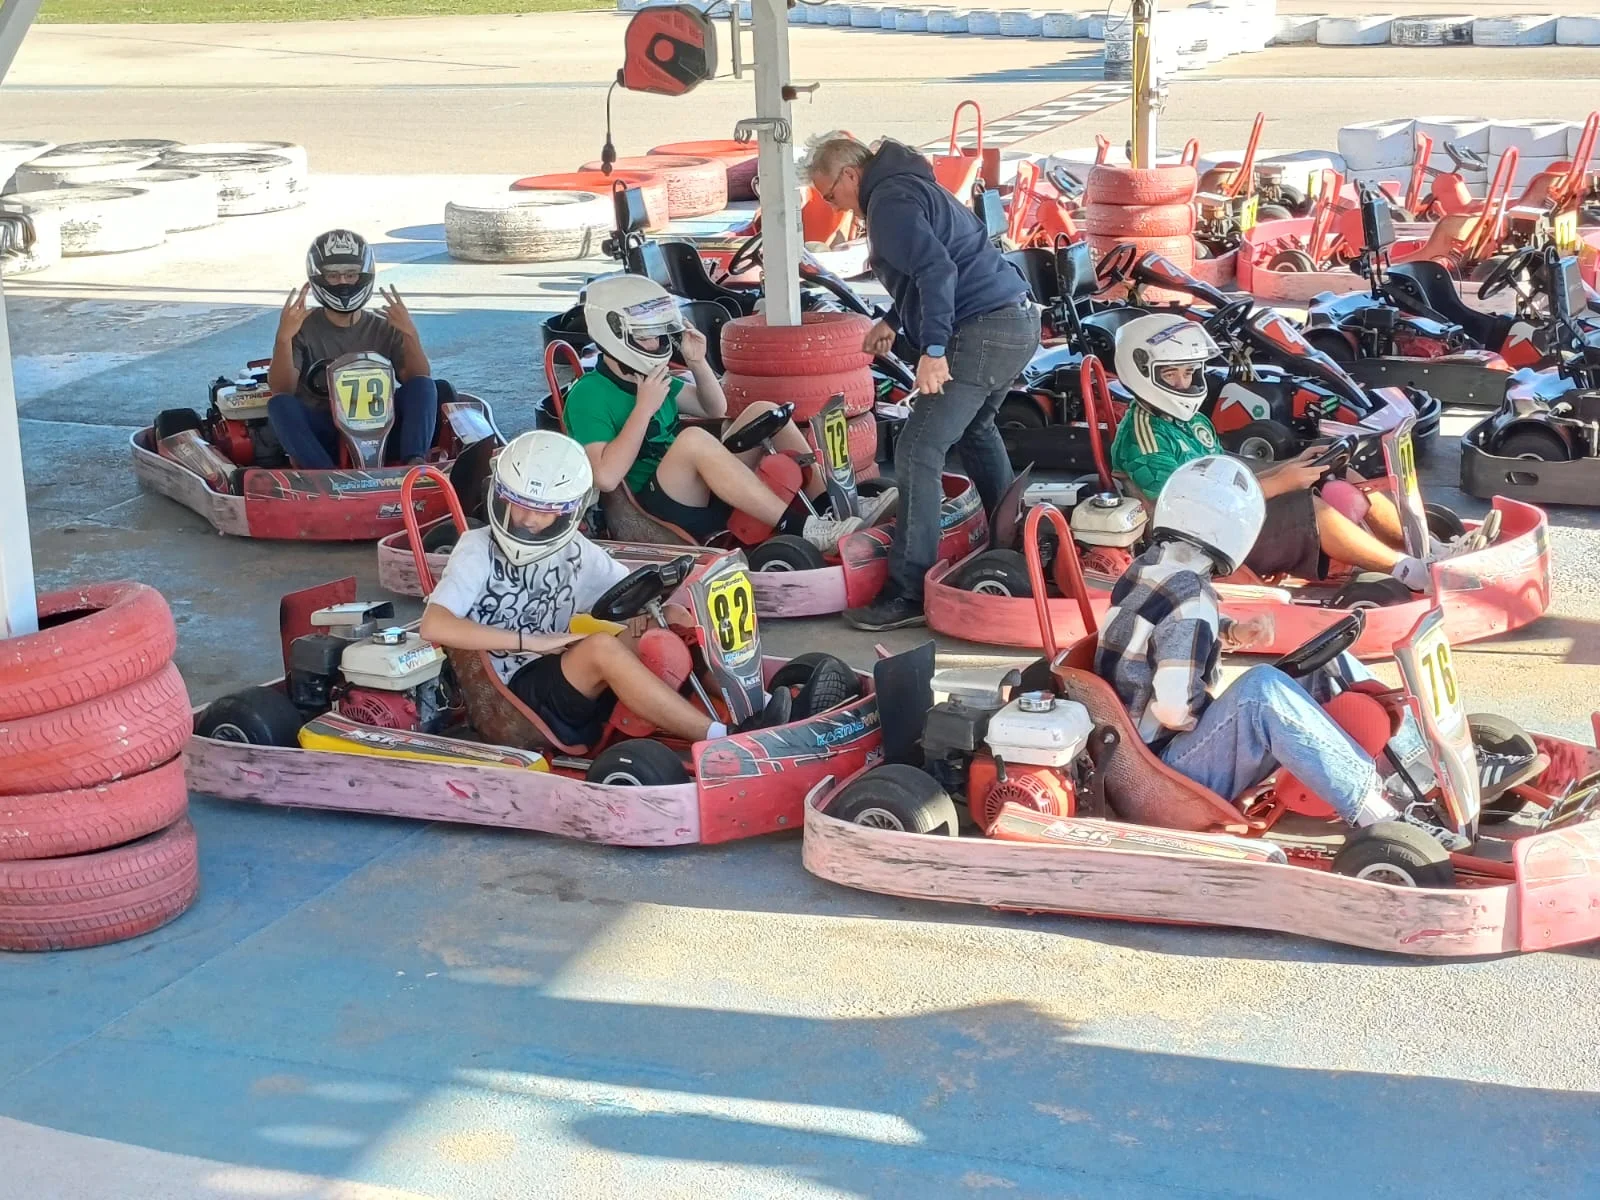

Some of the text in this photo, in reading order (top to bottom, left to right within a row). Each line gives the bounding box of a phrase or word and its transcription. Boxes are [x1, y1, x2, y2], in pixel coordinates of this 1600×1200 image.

[341, 378, 385, 418] 73
[826, 421, 848, 467] 72
[714, 586, 753, 651] 82
[1421, 642, 1457, 716] 76
